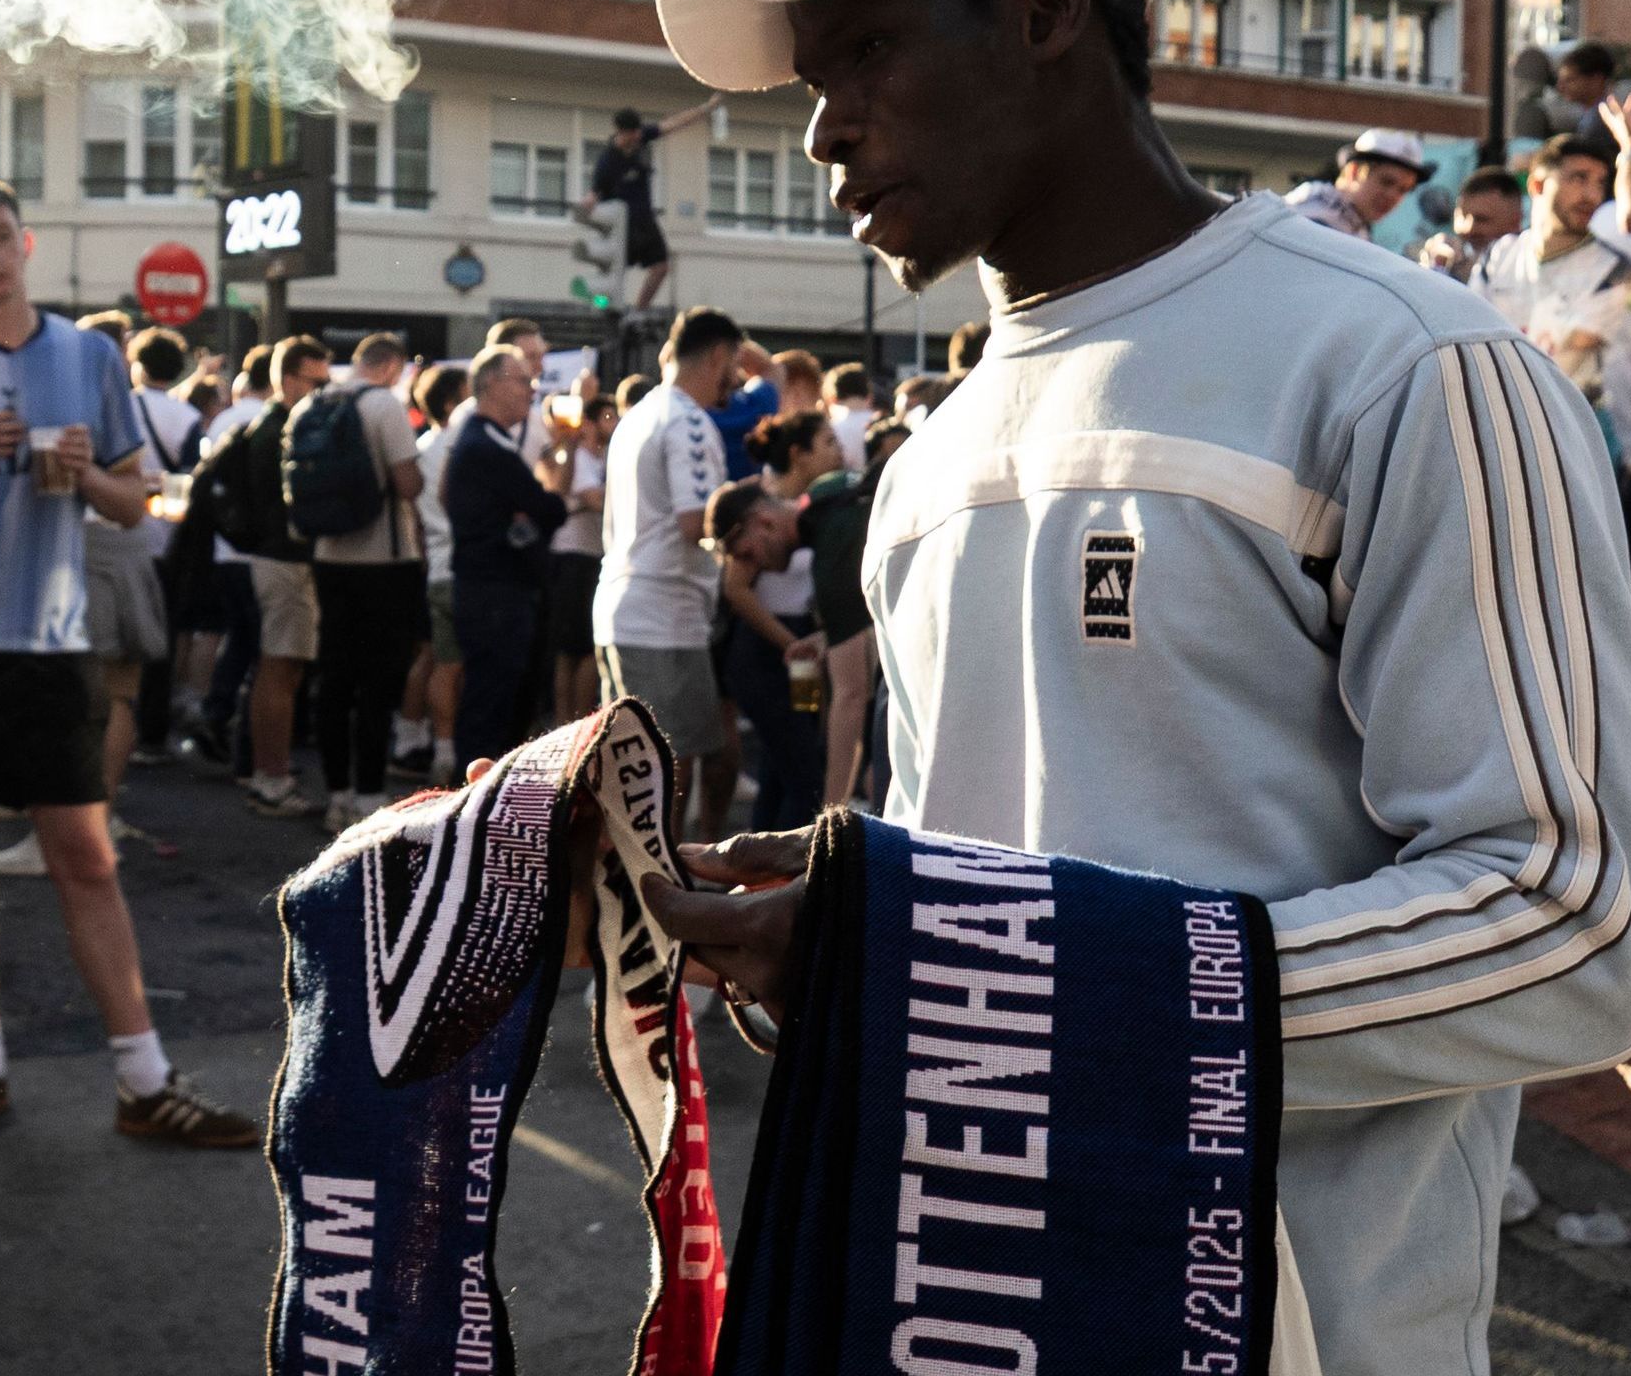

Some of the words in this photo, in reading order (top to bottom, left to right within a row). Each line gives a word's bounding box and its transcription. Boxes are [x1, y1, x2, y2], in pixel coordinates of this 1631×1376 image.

[1183, 900, 1244, 1021] EUROPA
[466, 1083, 506, 1222] LEAGUE
[1188, 1050, 1246, 1156] FINAL
[454, 1251, 493, 1376] UROPA
